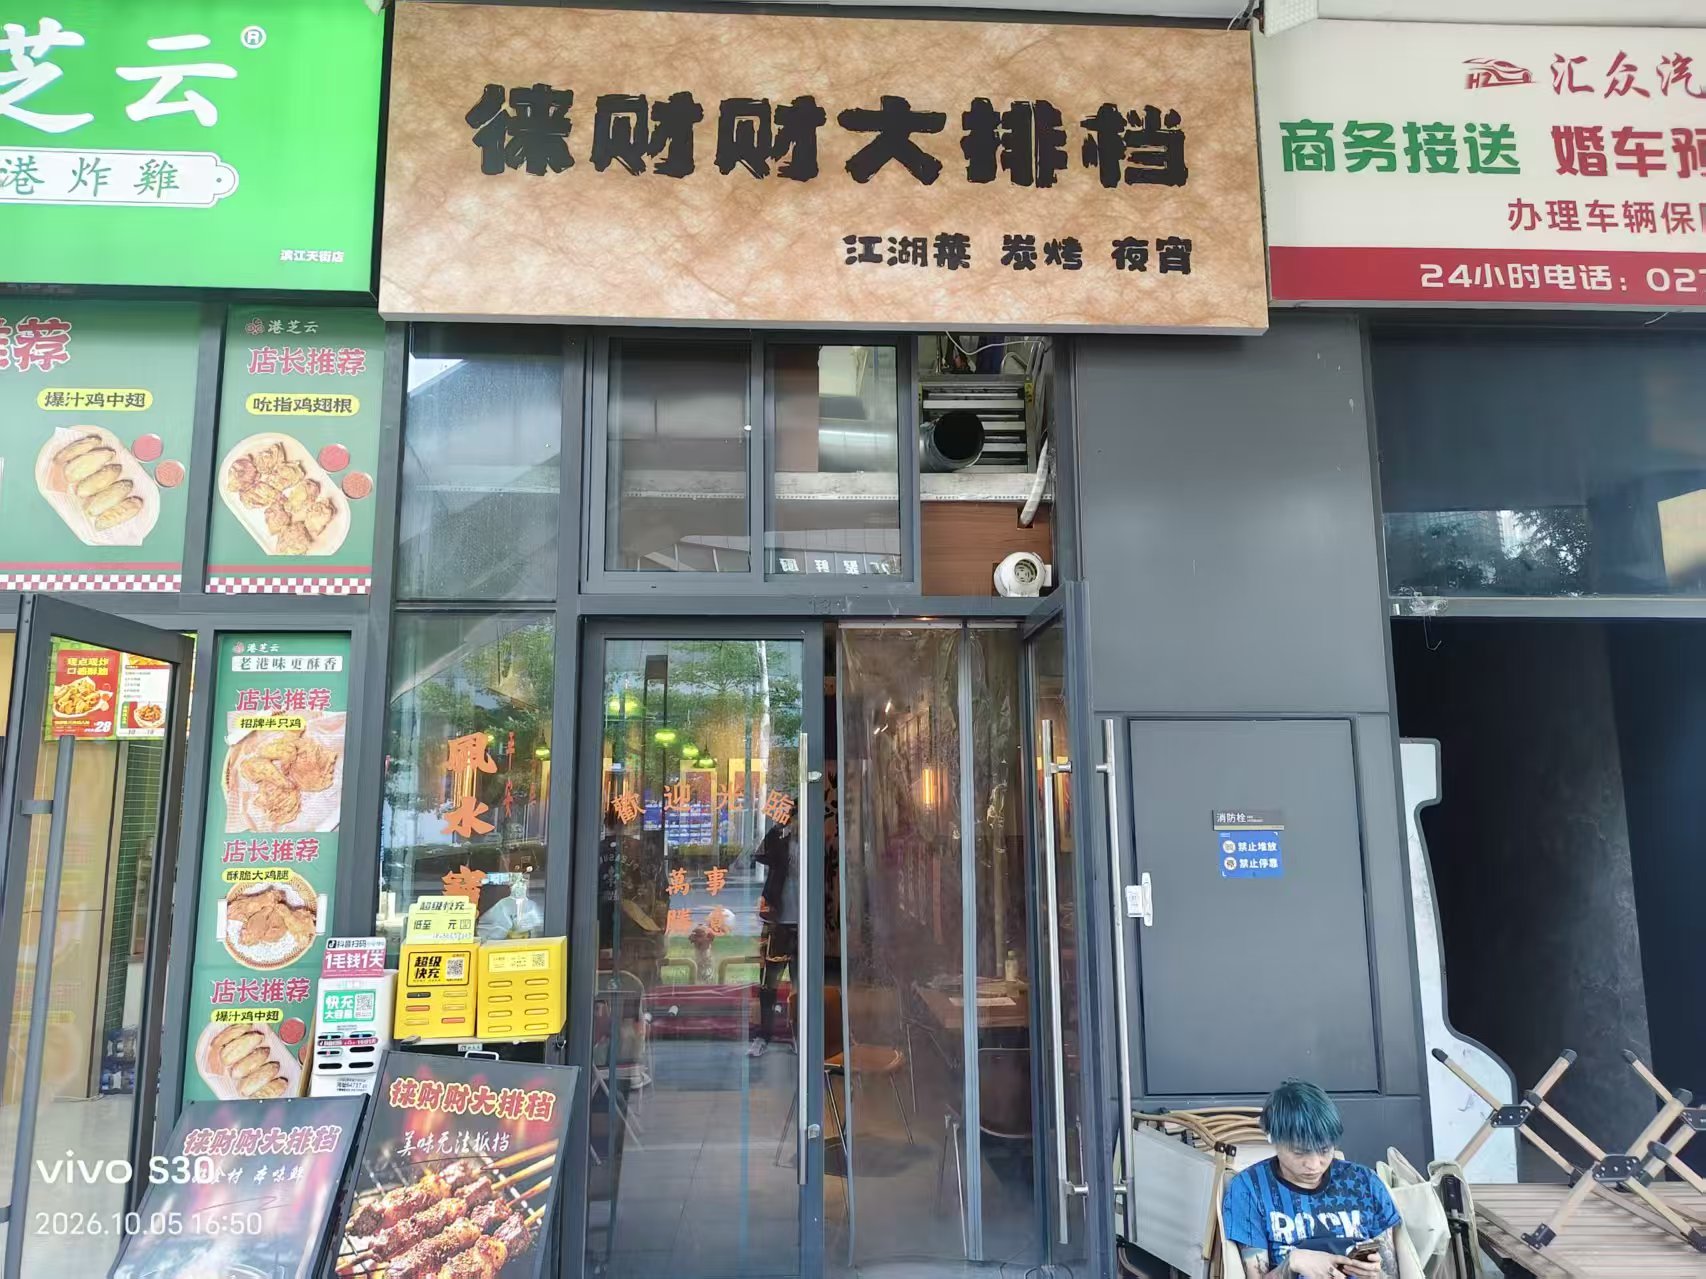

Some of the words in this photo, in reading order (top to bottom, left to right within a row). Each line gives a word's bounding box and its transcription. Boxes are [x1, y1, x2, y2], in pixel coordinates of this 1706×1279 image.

[0, 17, 238, 133] 芝云
[1549, 50, 1706, 99] 汇众汽
[1279, 118, 1520, 175] 商务接送
[1508, 198, 1706, 236] 办理车辆保
[280, 249, 344, 263] 滨江天街店
[842, 232, 972, 270] 江湖菜
[1000, 234, 1084, 271] 炭烤
[1111, 236, 1193, 275] 夜宵
[268, 320, 318, 334] 港芝云
[0, 316, 72, 372] 荐
[248, 346, 366, 376] 店长推荐
[44, 391, 146, 408] 爆汁鸡中翅
[252, 397, 352, 413] 吮指鸡翅根
[240, 657, 337, 671] 老港味更酥香
[236, 688, 331, 711] 店长推荐
[240, 717, 301, 729] 招牌半只鸡
[611, 781, 795, 825] 歡迎光臨
[1216, 812, 1246, 823] 消防栓
[222, 839, 320, 864] 店长推荐
[226, 869, 289, 882] 酥脆大鸡腿
[414, 956, 442, 968] 超级
[415, 967, 440, 979] 快充
[209, 978, 310, 1004] 店长推荐
[215, 1010, 280, 1023] 爆汁鸡中翅
